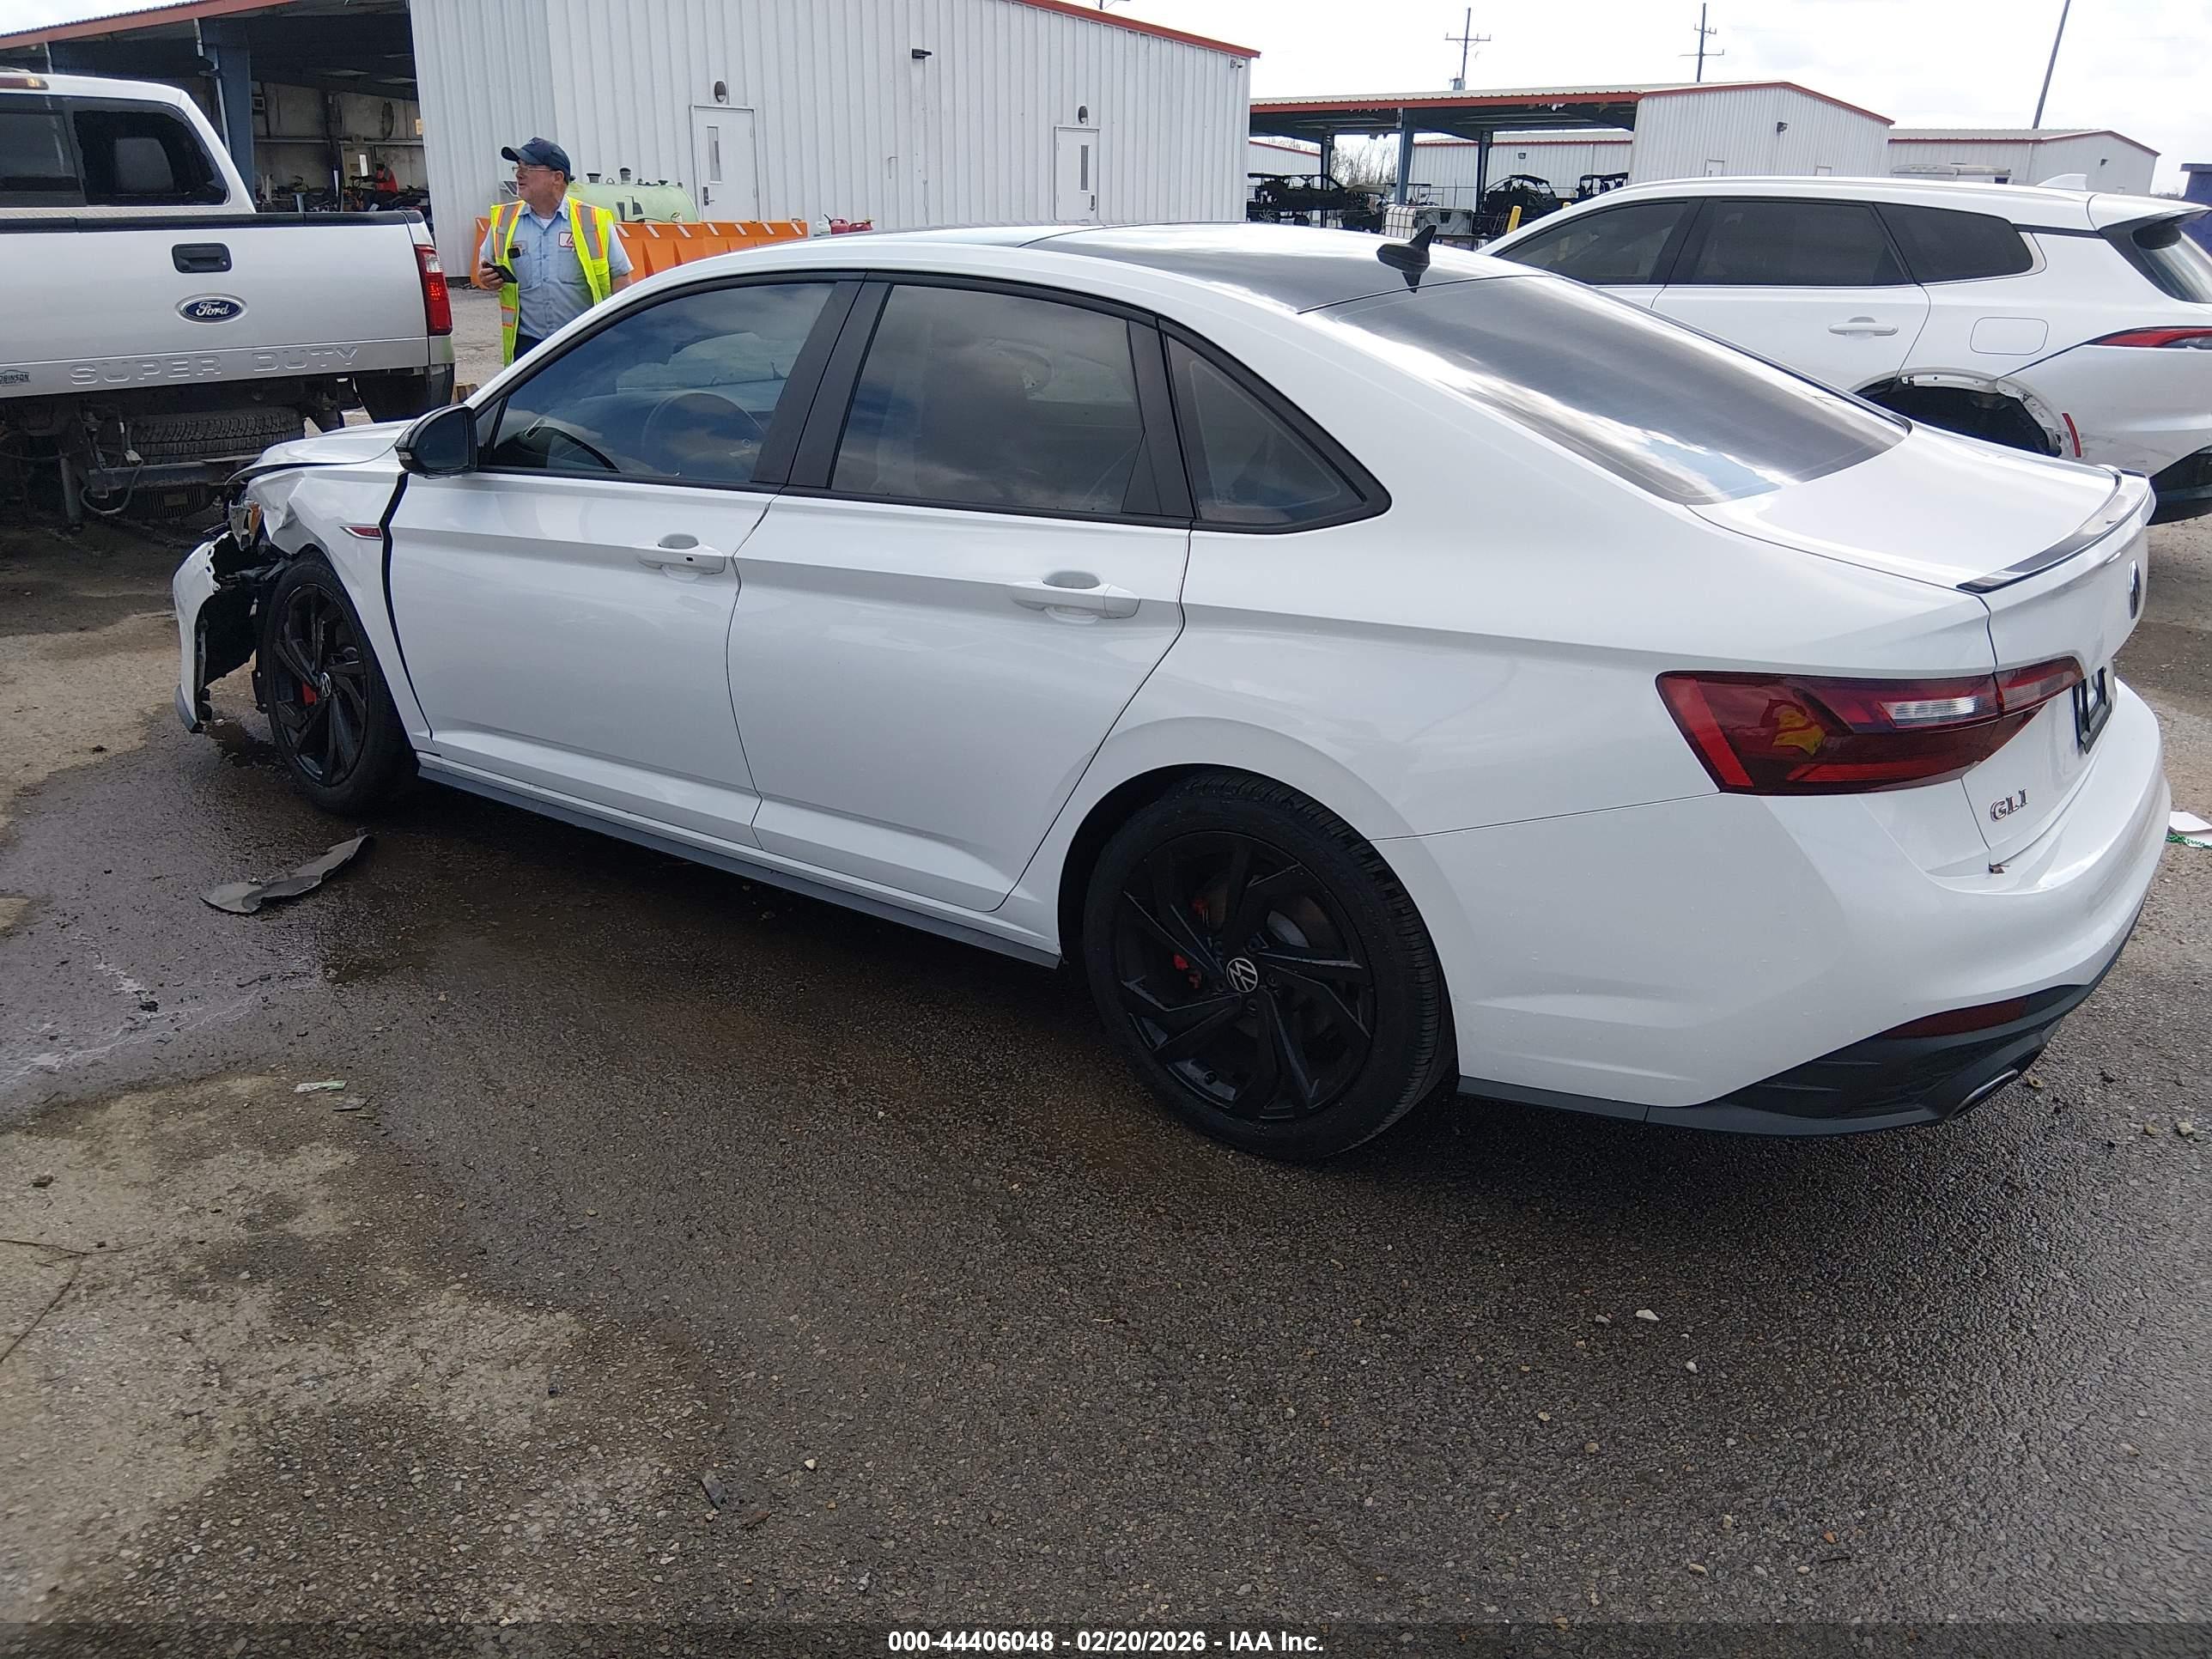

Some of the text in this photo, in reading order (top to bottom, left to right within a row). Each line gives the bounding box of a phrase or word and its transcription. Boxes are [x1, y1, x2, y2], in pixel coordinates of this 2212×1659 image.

[196, 301, 229, 317] Ford
[70, 346, 358, 386] SUPER DUTY
[1990, 788, 2028, 822] GLI
